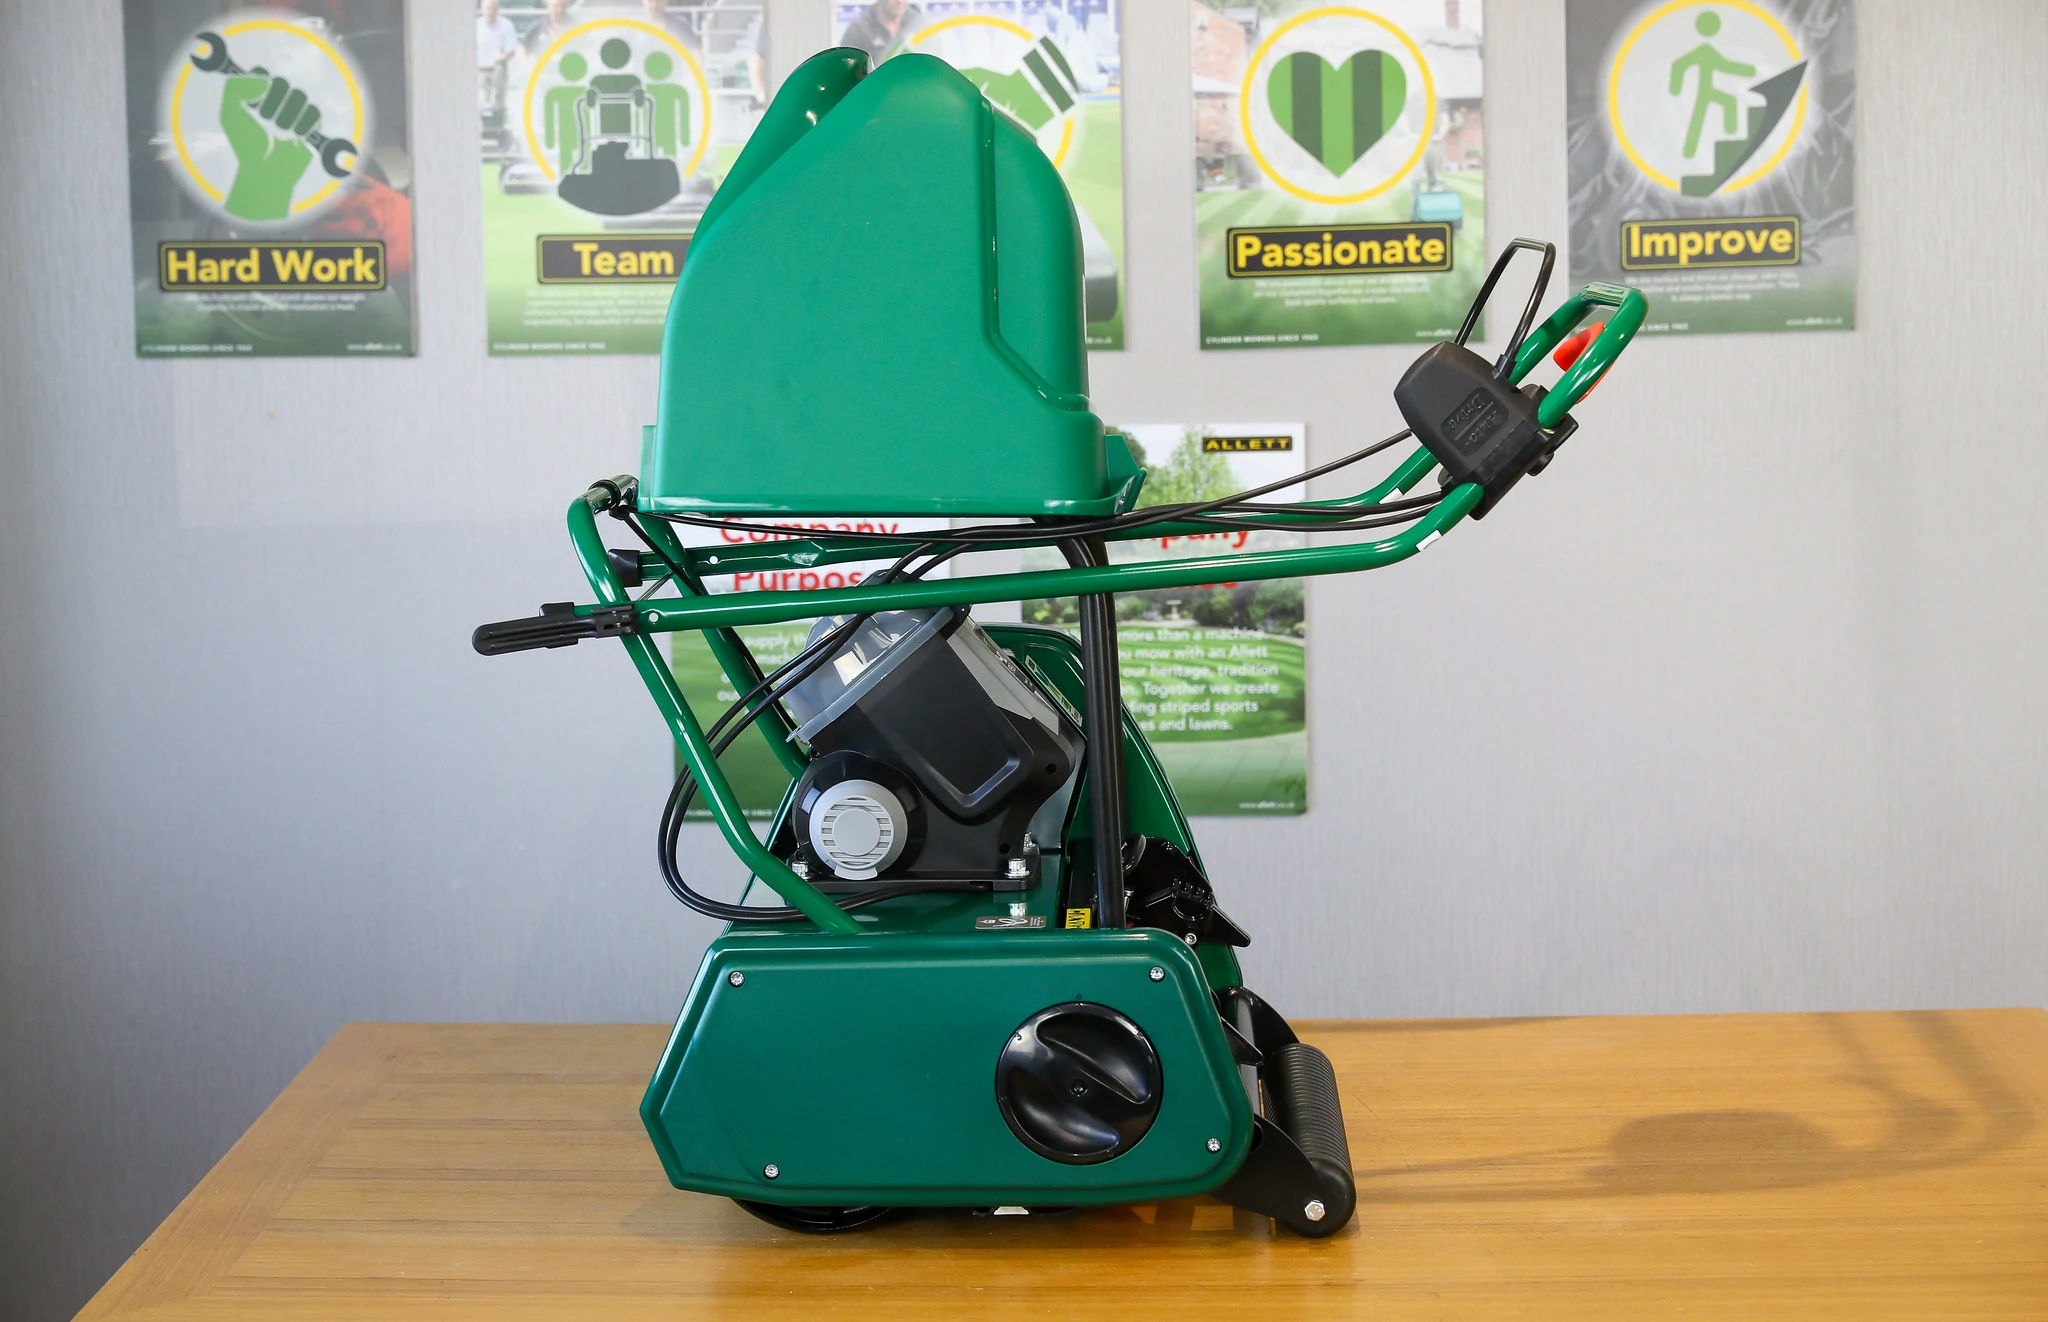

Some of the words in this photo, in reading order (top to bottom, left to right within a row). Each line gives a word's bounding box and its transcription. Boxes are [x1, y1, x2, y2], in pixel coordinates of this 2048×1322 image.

[1236, 232, 1446, 269] Passionate
[1630, 224, 1794, 265] Improve
[168, 248, 260, 283] Hard
[272, 248, 377, 283] Work
[572, 242, 674, 276] Team
[1206, 436, 1290, 450] ALLETT
[733, 571, 863, 592] Purpos
[743, 633, 790, 651] supply
[1118, 630, 1154, 642] more
[1157, 628, 1190, 641] than
[1193, 630, 1202, 641] a
[1135, 649, 1170, 660] mow
[1173, 645, 1205, 659] with
[1207, 648, 1226, 659] an
[1229, 645, 1268, 659] Allett
[1122, 667, 1146, 678] our
[1150, 665, 1214, 680] heritage,
[1217, 662, 1279, 677] tradition
[1142, 681, 1206, 698] Together
[1209, 684, 1231, 695] we
[1234, 683, 1279, 695] create
[1160, 699, 1211, 715] striped
[1213, 700, 1259, 716] sports
[1159, 717, 1186, 731] and
[1189, 716, 1233, 731] lawns.
